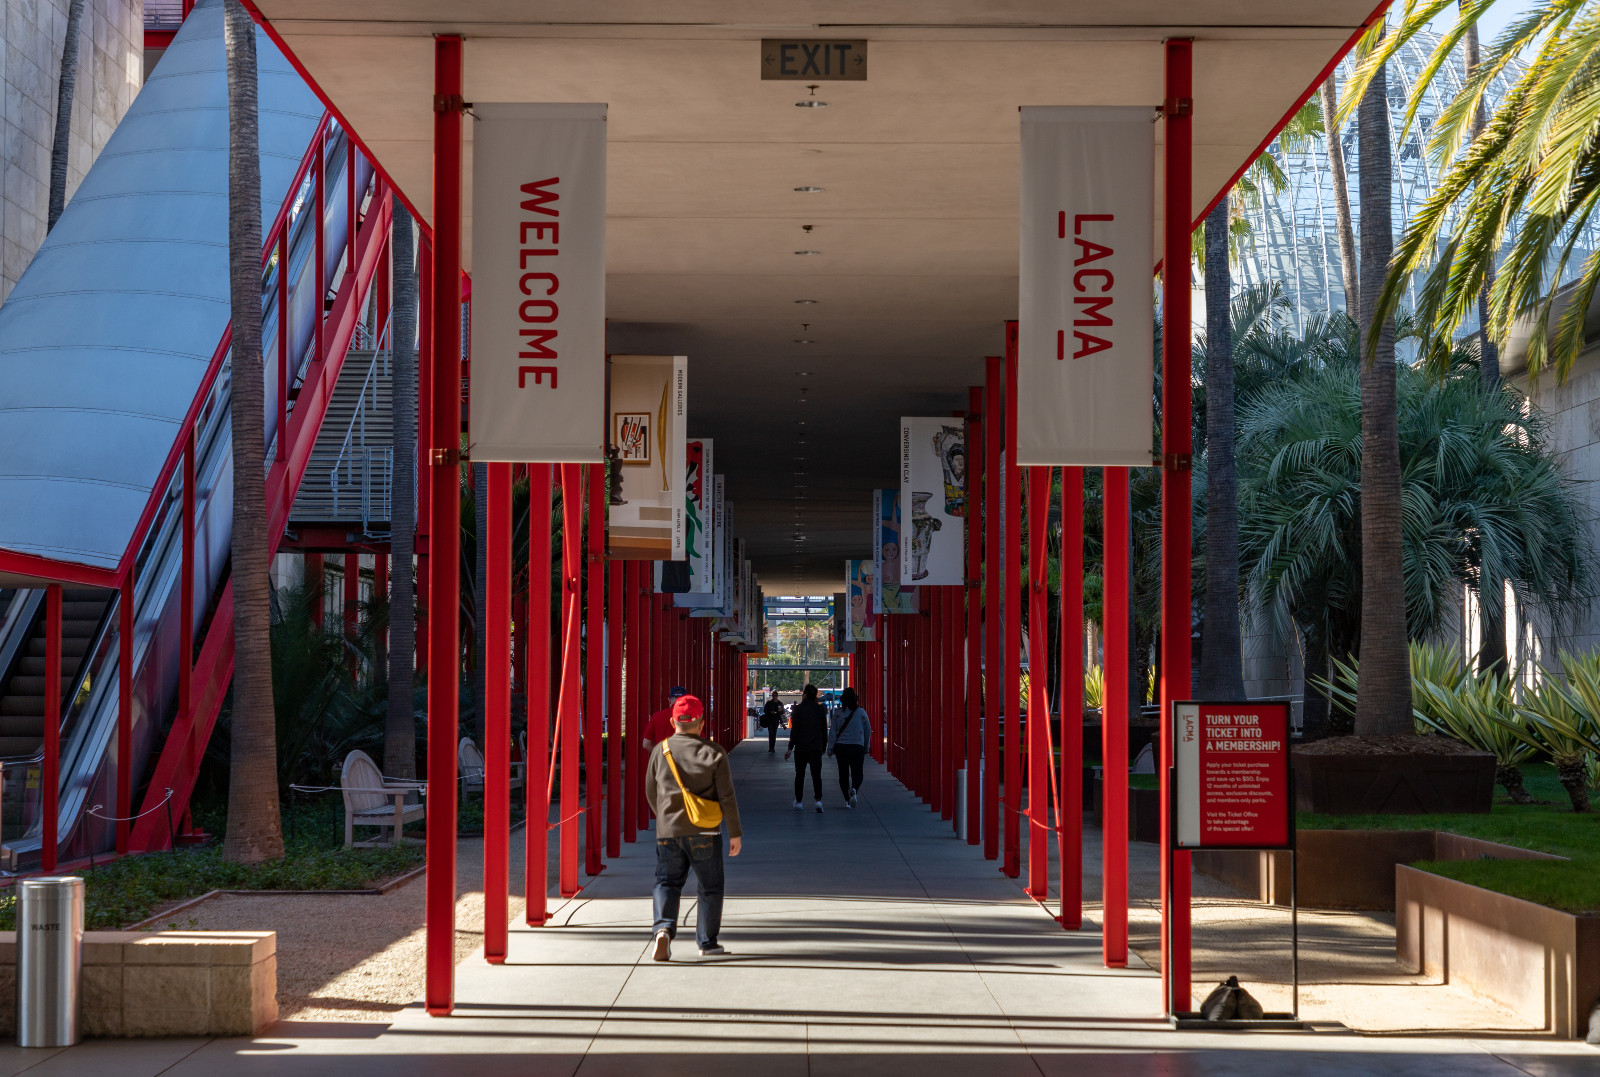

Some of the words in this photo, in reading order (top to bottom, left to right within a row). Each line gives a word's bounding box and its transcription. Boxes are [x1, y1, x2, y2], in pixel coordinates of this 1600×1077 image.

[780, 44, 852, 75] EXIT
[518, 176, 560, 389] WELCOME
[1072, 213, 1115, 360] LACMA
[1185, 714, 1195, 742] LACMA
[1205, 714, 1231, 725] TURN
[1233, 714, 1259, 725] YOUR
[1205, 727, 1238, 738] TICKET
[1240, 727, 1262, 738] INTO
[1205, 740, 1213, 751] A
[1215, 740, 1281, 751] MEMBERSHIP!
[31, 923, 61, 931] WASTE
